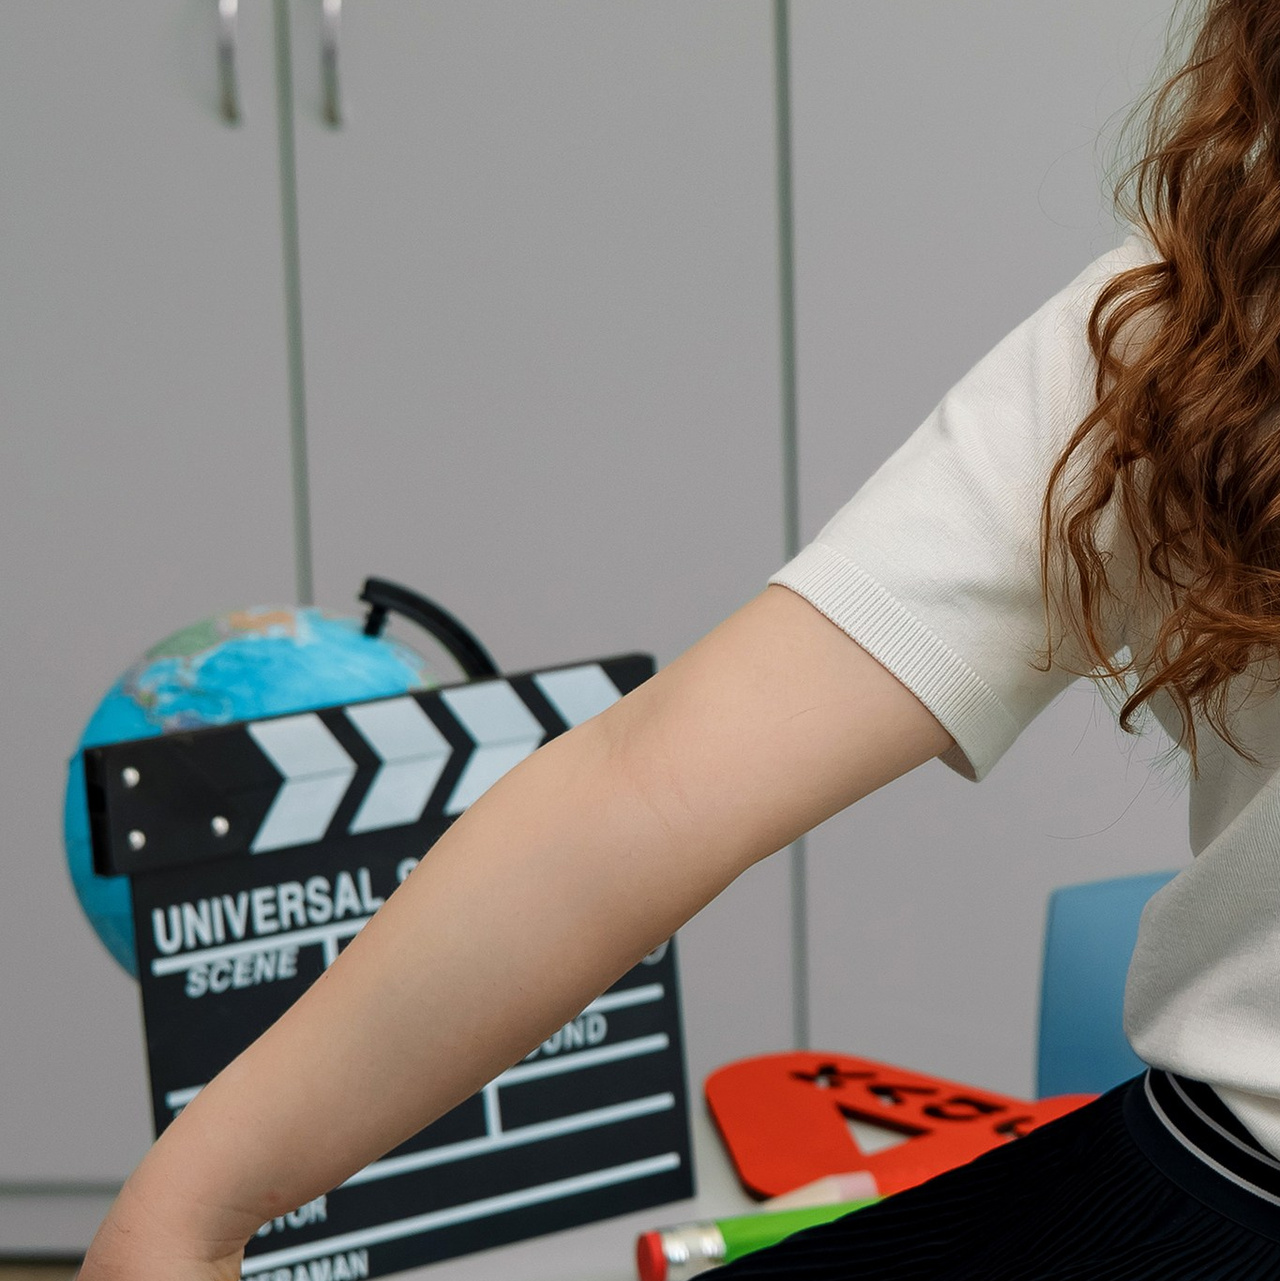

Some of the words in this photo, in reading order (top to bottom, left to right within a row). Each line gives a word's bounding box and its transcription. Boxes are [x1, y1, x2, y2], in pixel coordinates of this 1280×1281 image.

[151, 866, 386, 956] UNIVERSAL
[184, 944, 299, 999] SCENE
[525, 1012, 608, 1061] UND
